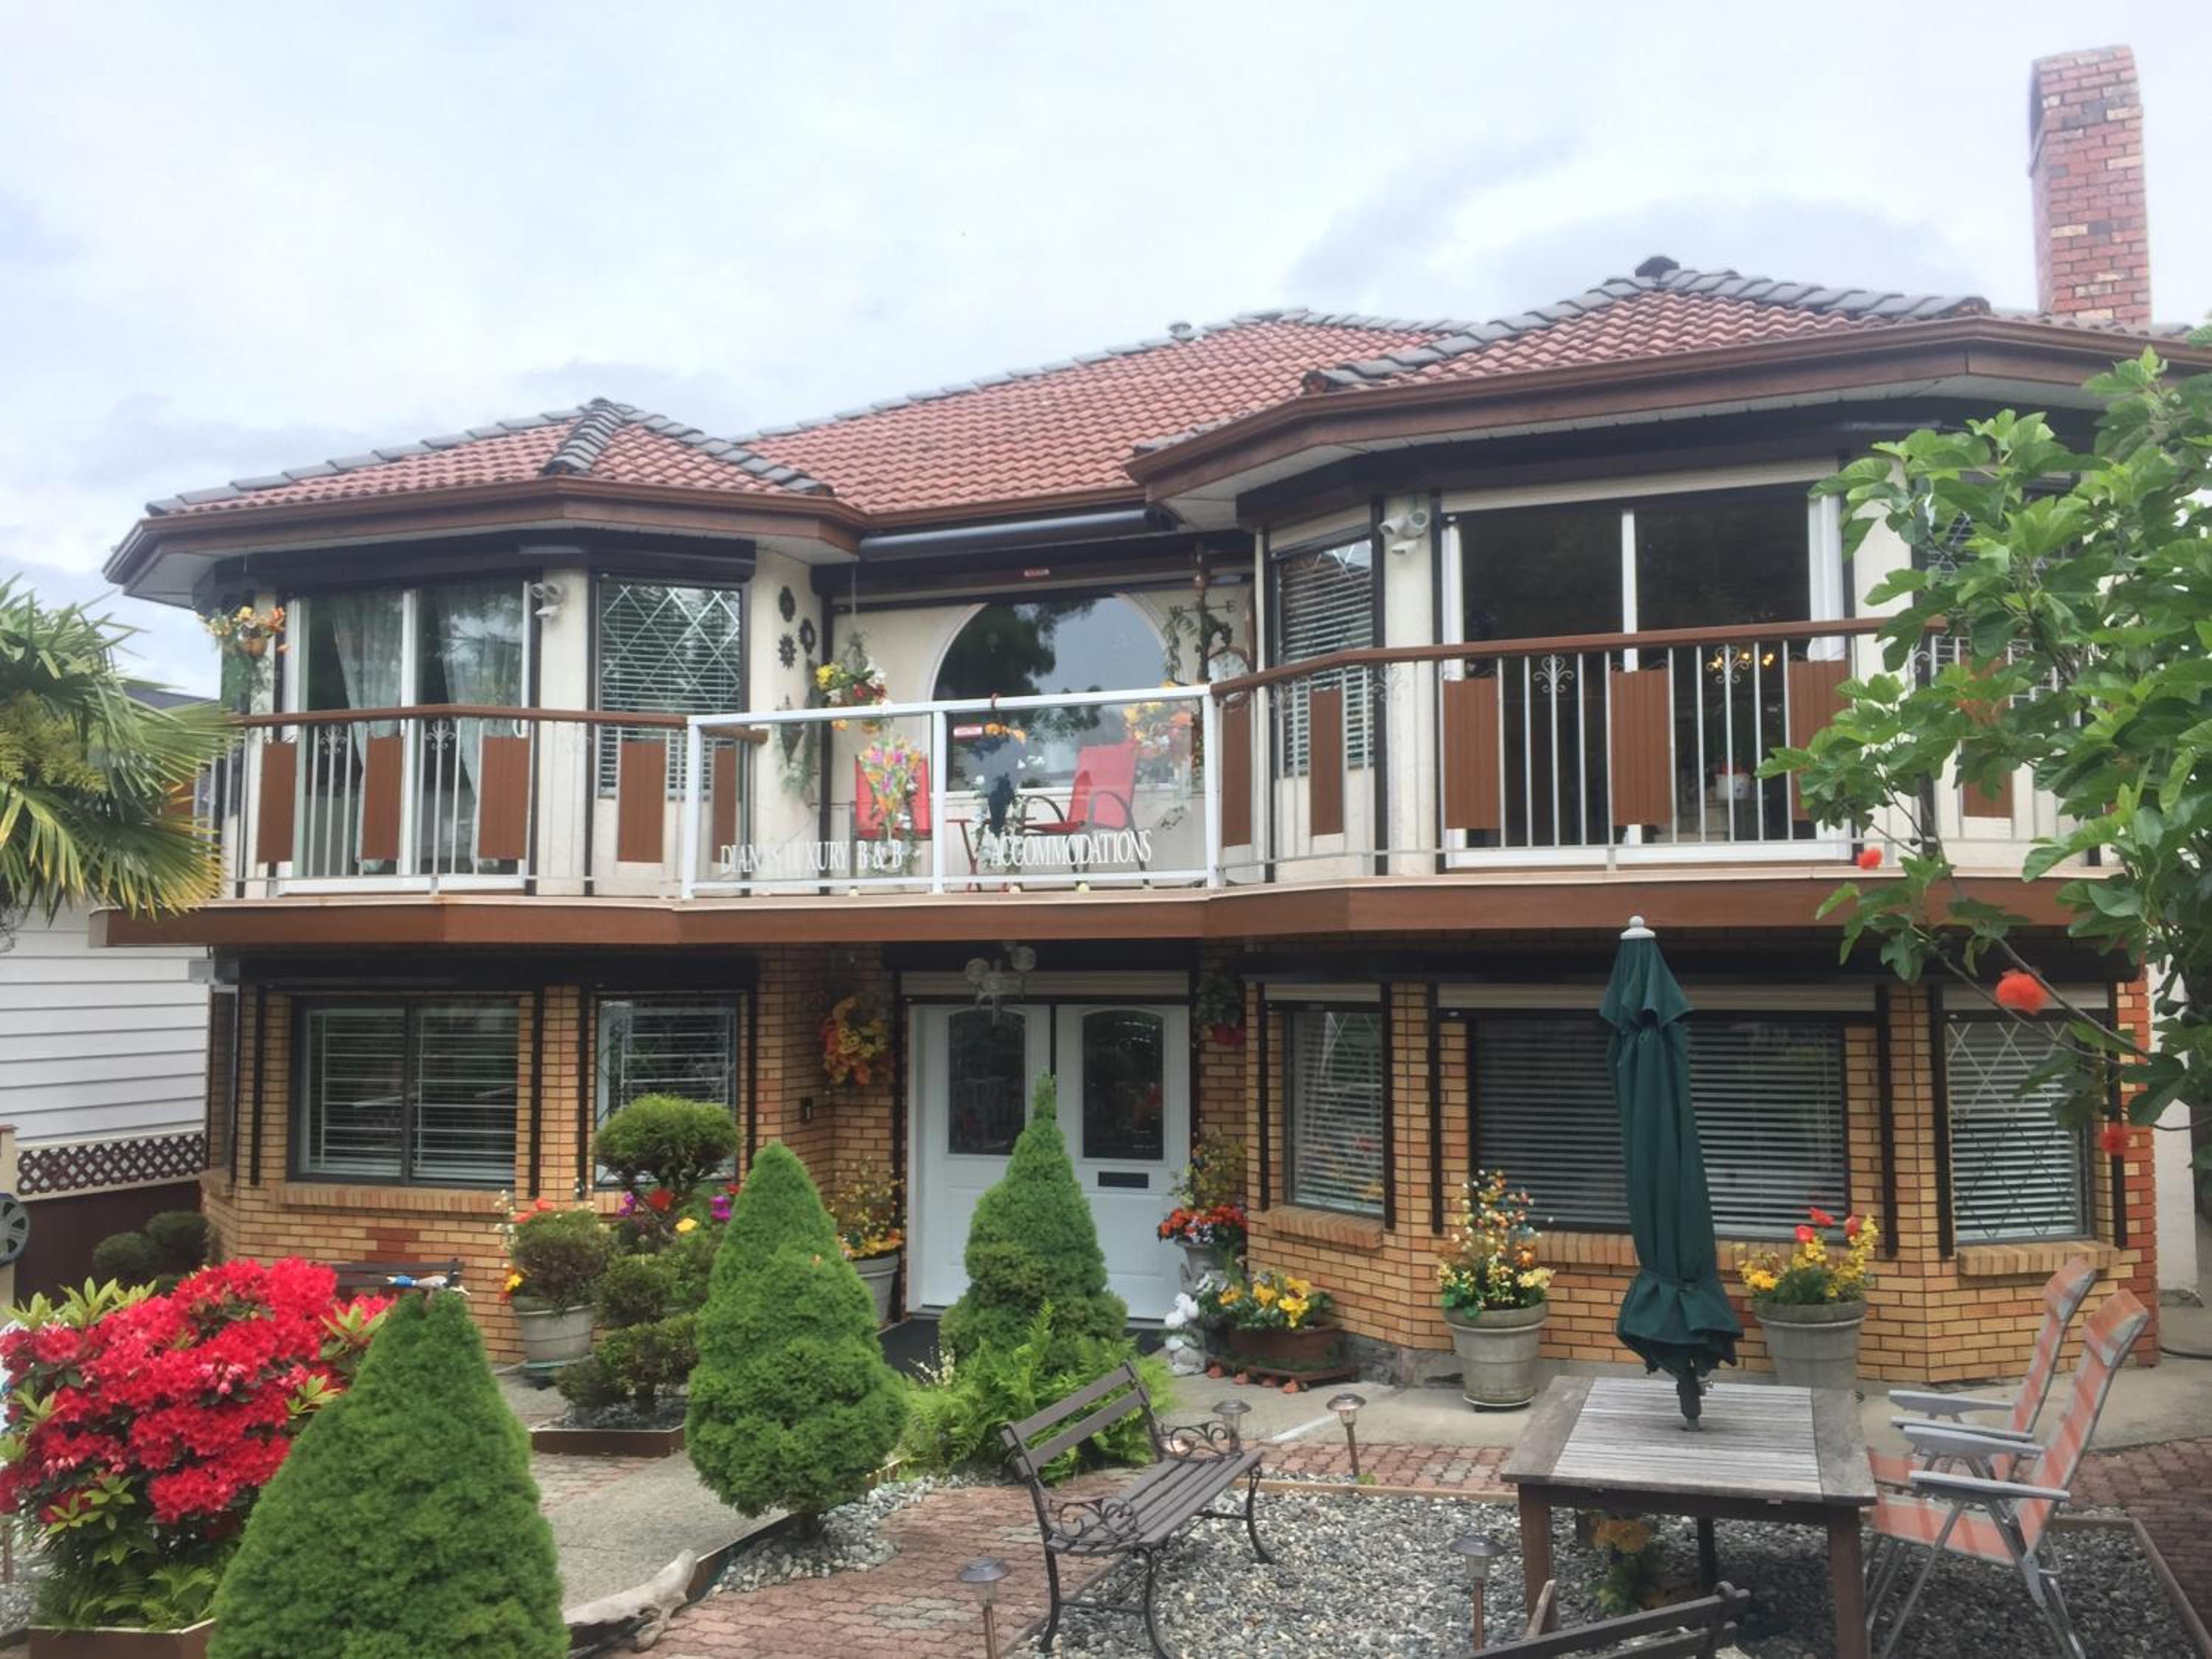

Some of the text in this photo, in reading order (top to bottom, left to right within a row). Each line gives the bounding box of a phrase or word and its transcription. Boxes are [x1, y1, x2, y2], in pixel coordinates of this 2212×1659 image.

[1226, 599, 1237, 613] E
[785, 840, 849, 871] LXURY
[857, 840, 869, 870] B
[872, 841, 886, 872] &
[891, 839, 903, 869] B
[990, 829, 1152, 866] ACCOMMODATIONS
